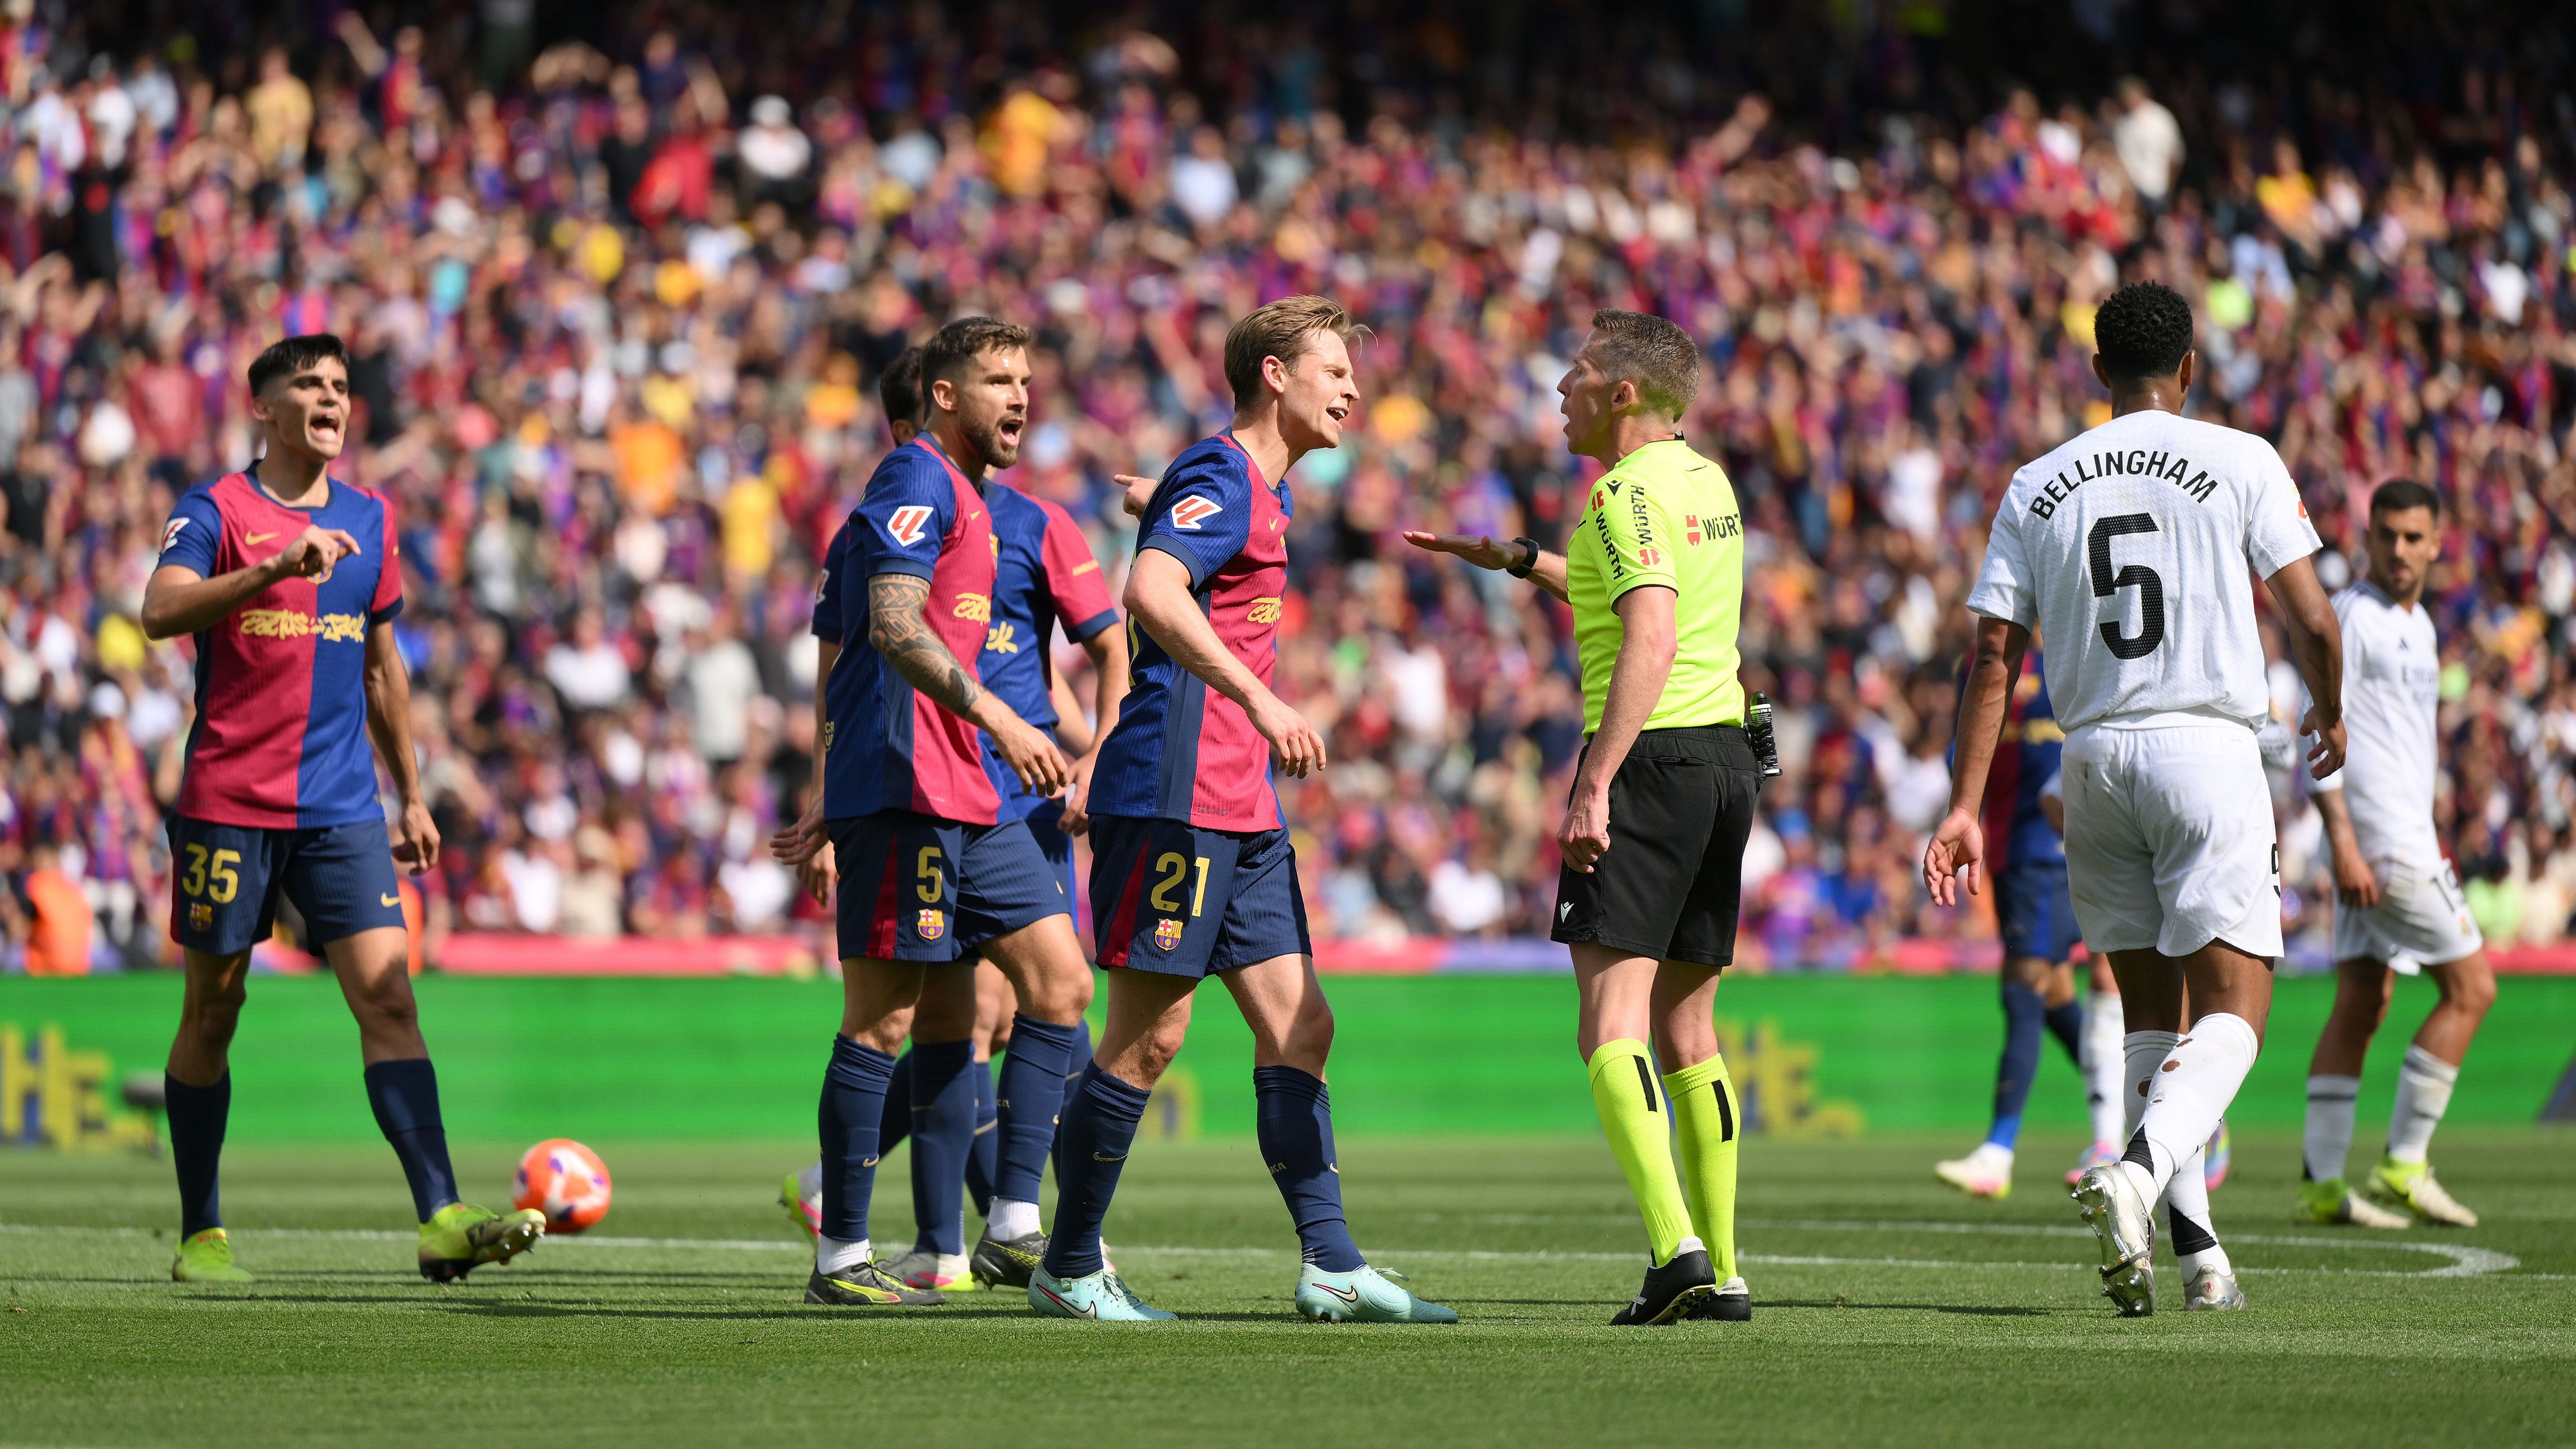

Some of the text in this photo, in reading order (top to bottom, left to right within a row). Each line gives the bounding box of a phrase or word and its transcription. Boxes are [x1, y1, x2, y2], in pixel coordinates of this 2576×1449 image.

[1630, 485, 1652, 545] WÜRTH
[2029, 450, 2218, 521] BELLINGHAM
[1595, 511, 1624, 581] WÜRTH
[1702, 514, 1742, 540] WÜRT
[2087, 512, 2165, 660] 5
[182, 842, 241, 904] 35
[917, 846, 943, 903] 5
[1151, 852, 1210, 917] 21
